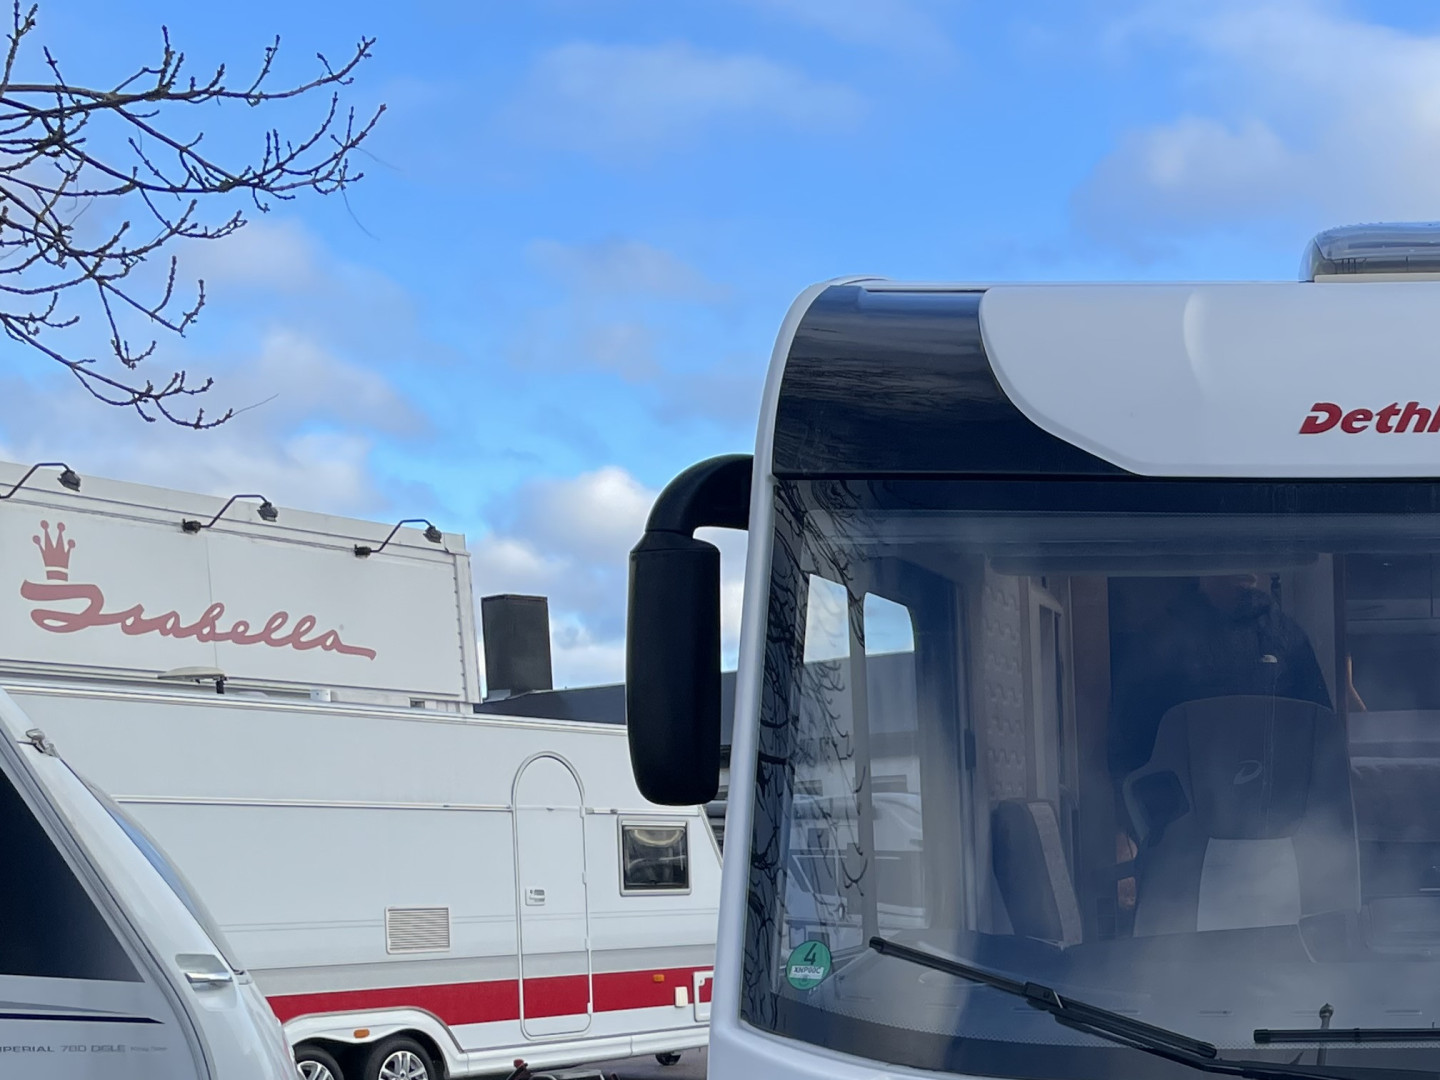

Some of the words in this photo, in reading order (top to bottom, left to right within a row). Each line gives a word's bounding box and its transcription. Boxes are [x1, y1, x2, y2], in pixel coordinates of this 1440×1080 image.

[20, 579, 377, 661] Isabella
[803, 942, 818, 966] 4
[0, 1045, 55, 1053] PERIAL
